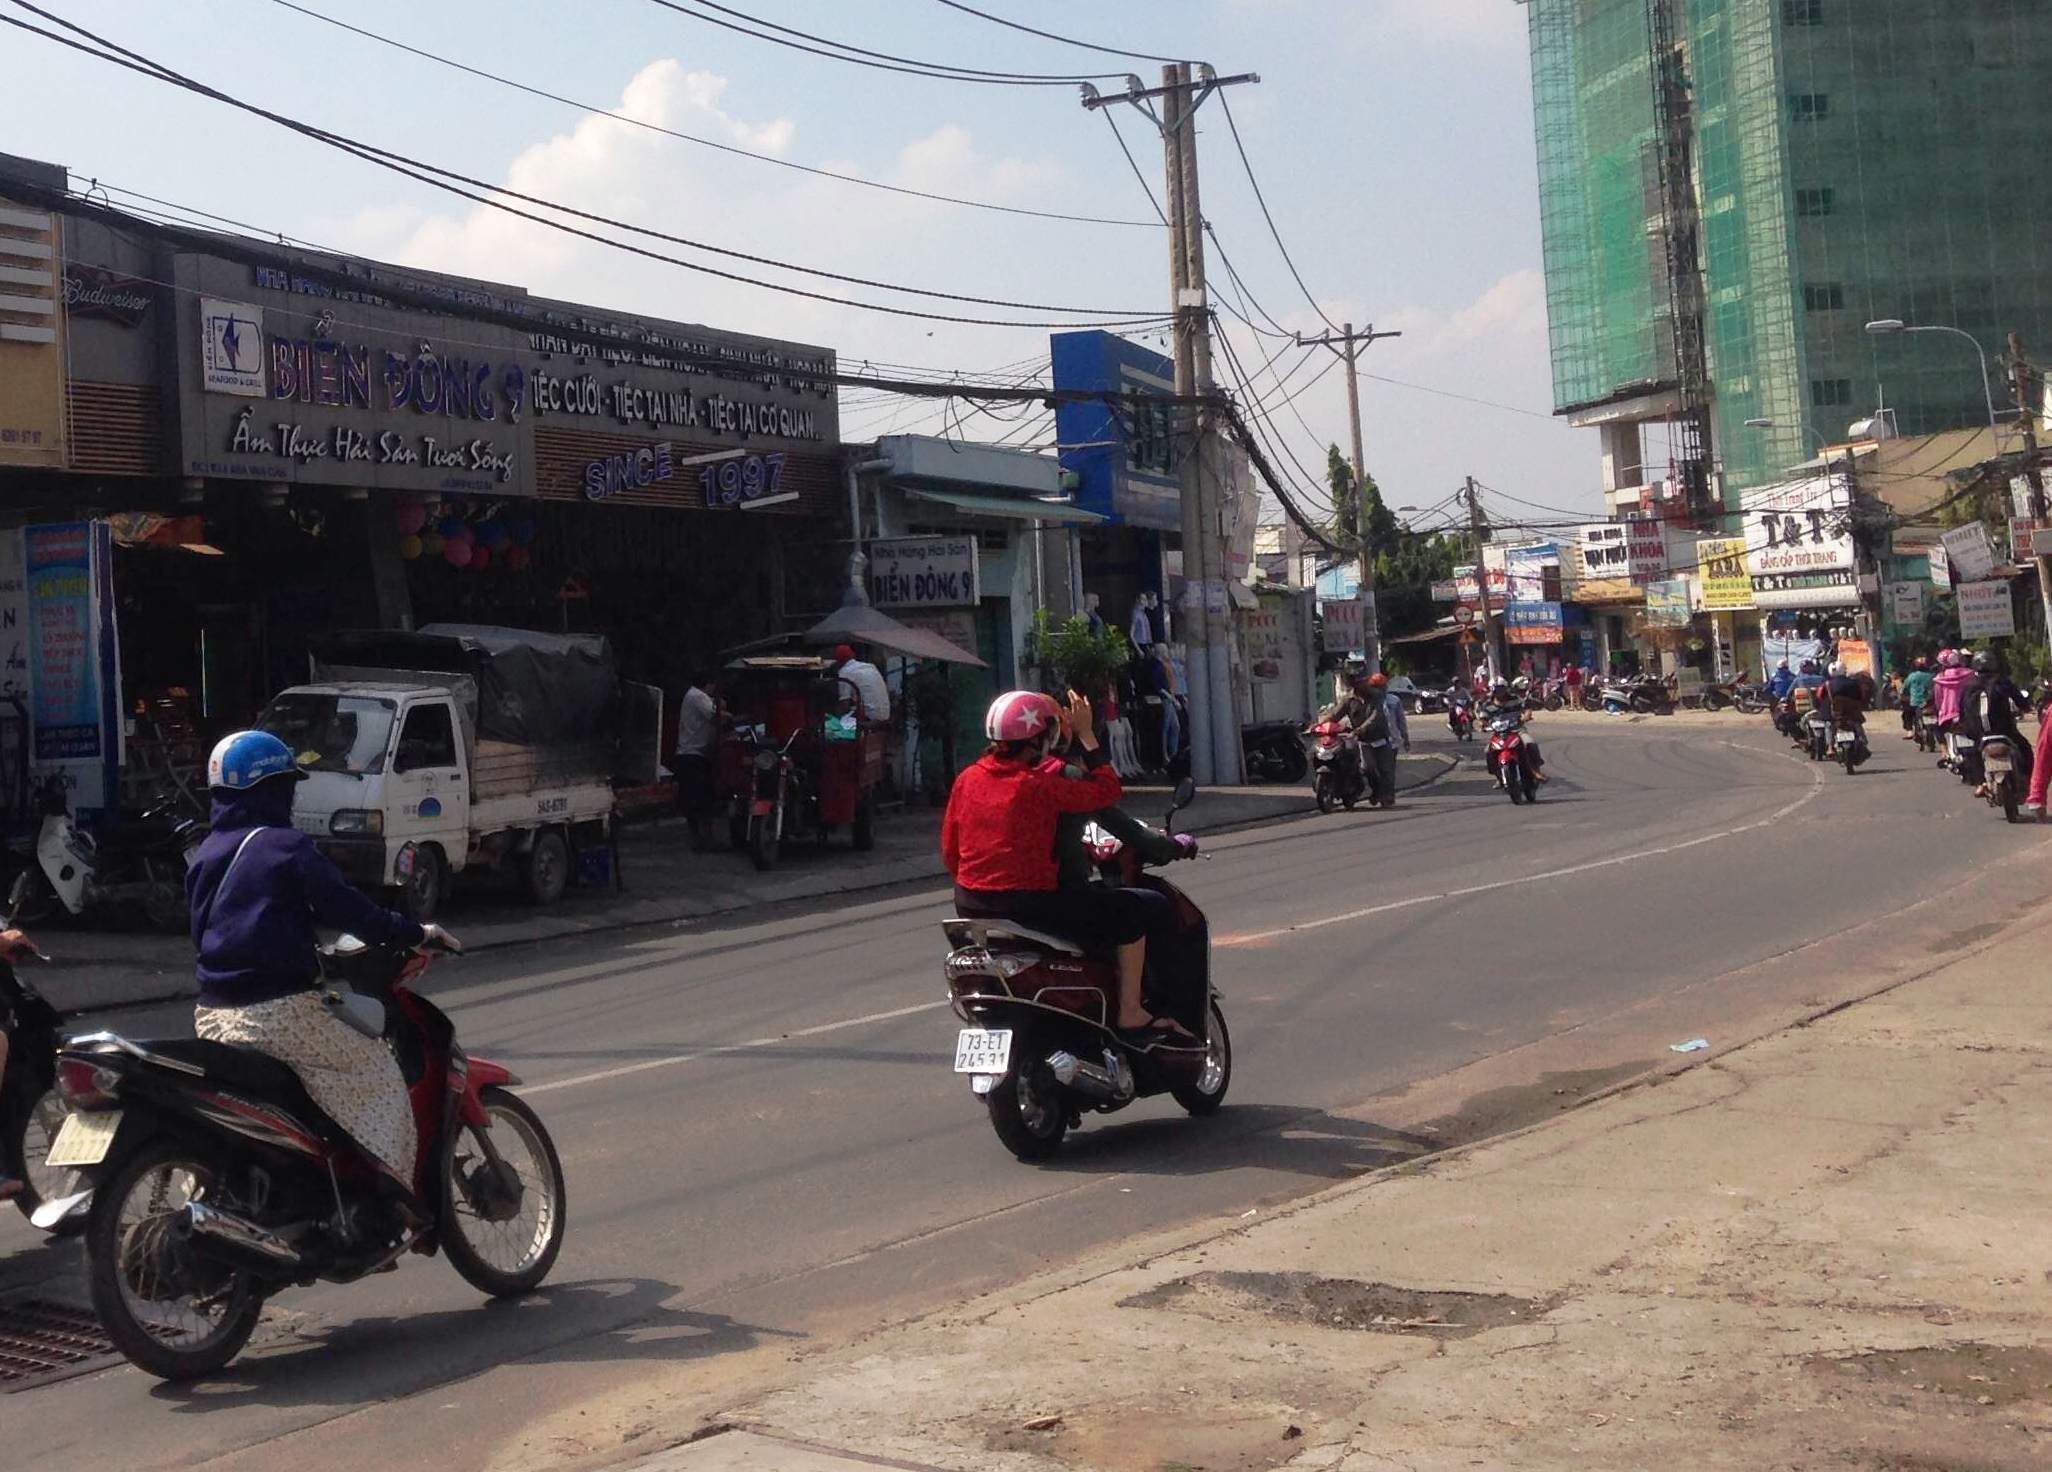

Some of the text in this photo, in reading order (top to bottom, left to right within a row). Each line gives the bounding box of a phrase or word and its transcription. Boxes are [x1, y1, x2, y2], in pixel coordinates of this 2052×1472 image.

[612, 381, 644, 425] TIỆC
[670, 388, 698, 427] NHÀ
[708, 394, 736, 434] TIỆC
[277, 423, 328, 464] Thực
[335, 426, 373, 462] Hải
[380, 430, 419, 465] Sản
[469, 439, 515, 482] Sống
[584, 442, 788, 507] SINCE 1997
[874, 560, 972, 603] BIỂN ĐÔNG 9
